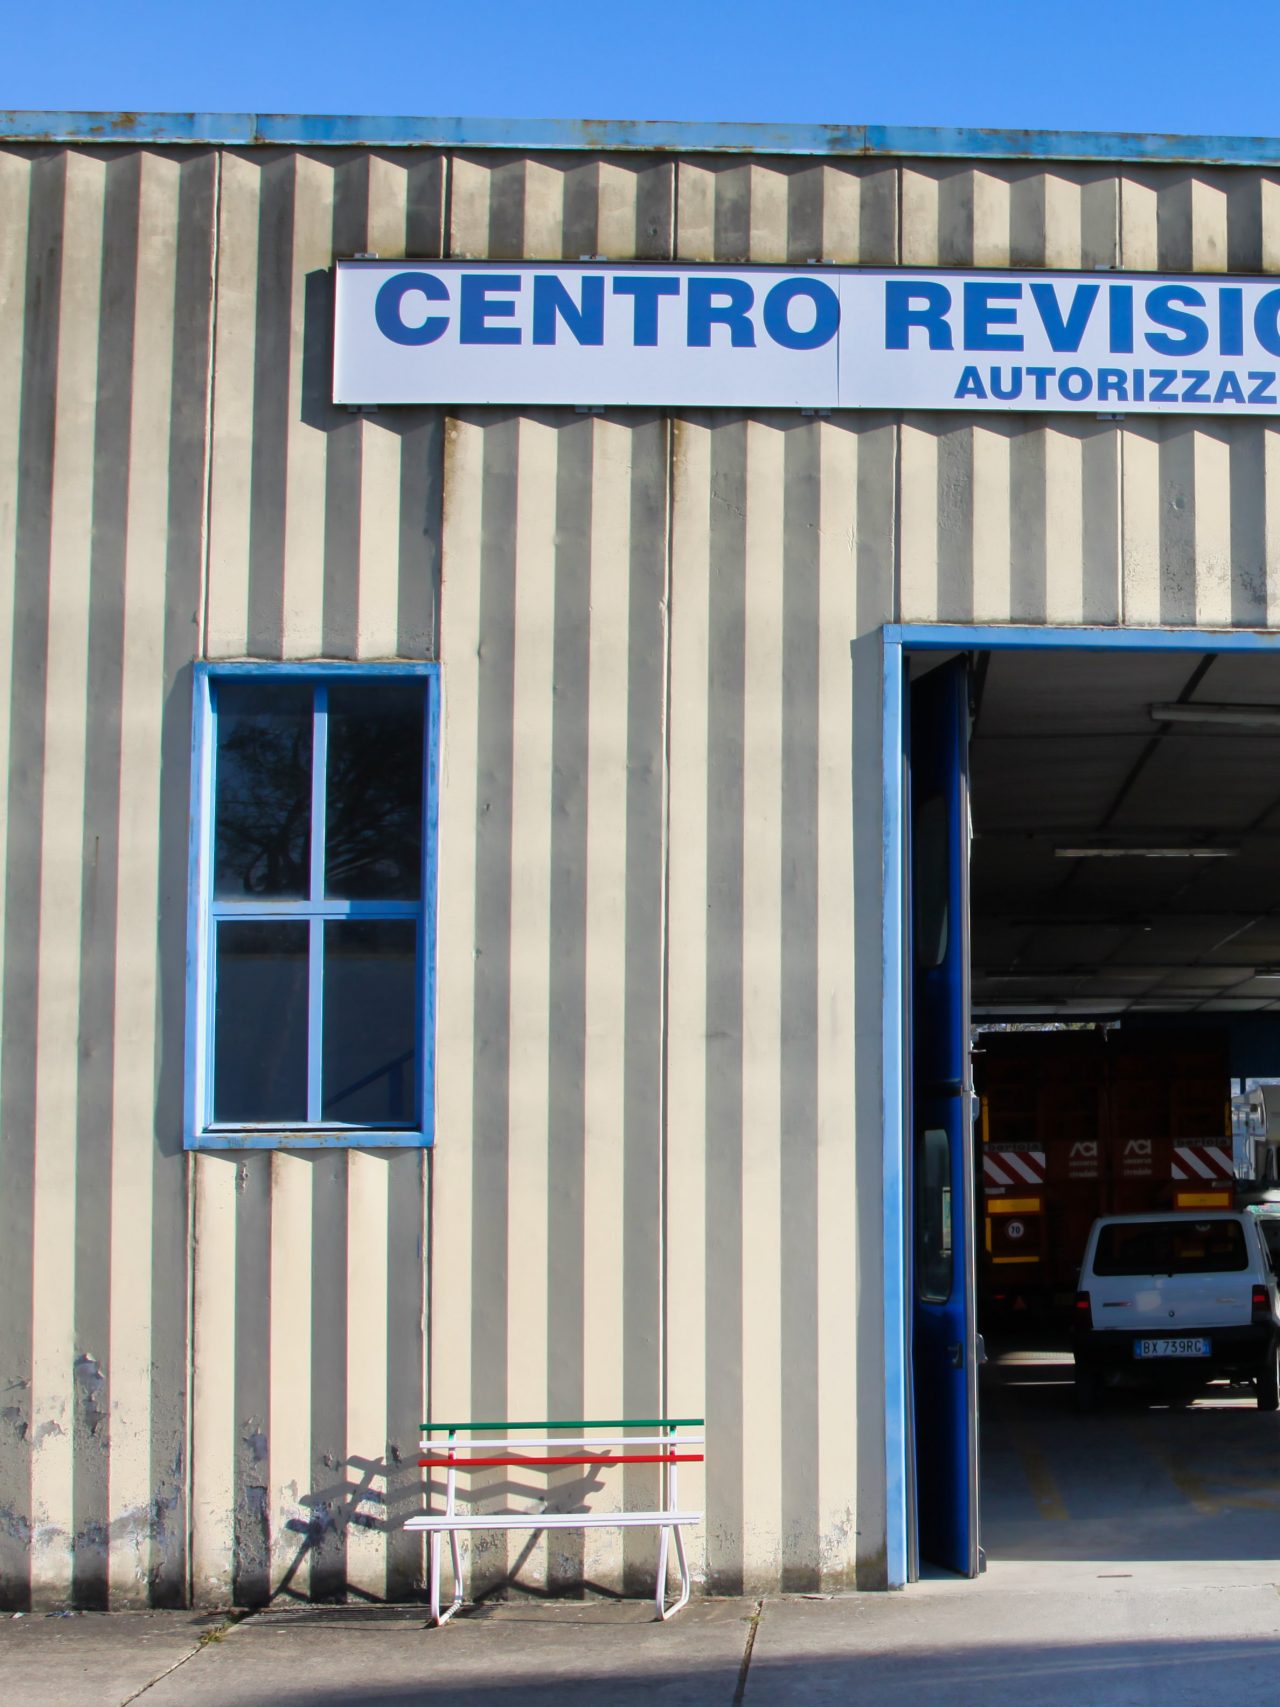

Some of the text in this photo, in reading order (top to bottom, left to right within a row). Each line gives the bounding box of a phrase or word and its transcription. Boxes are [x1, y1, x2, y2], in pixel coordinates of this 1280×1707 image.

[375, 272, 840, 350] CENTRO
[1011, 1226, 1021, 1234] 70
[1143, 1341, 1158, 1354] BX
